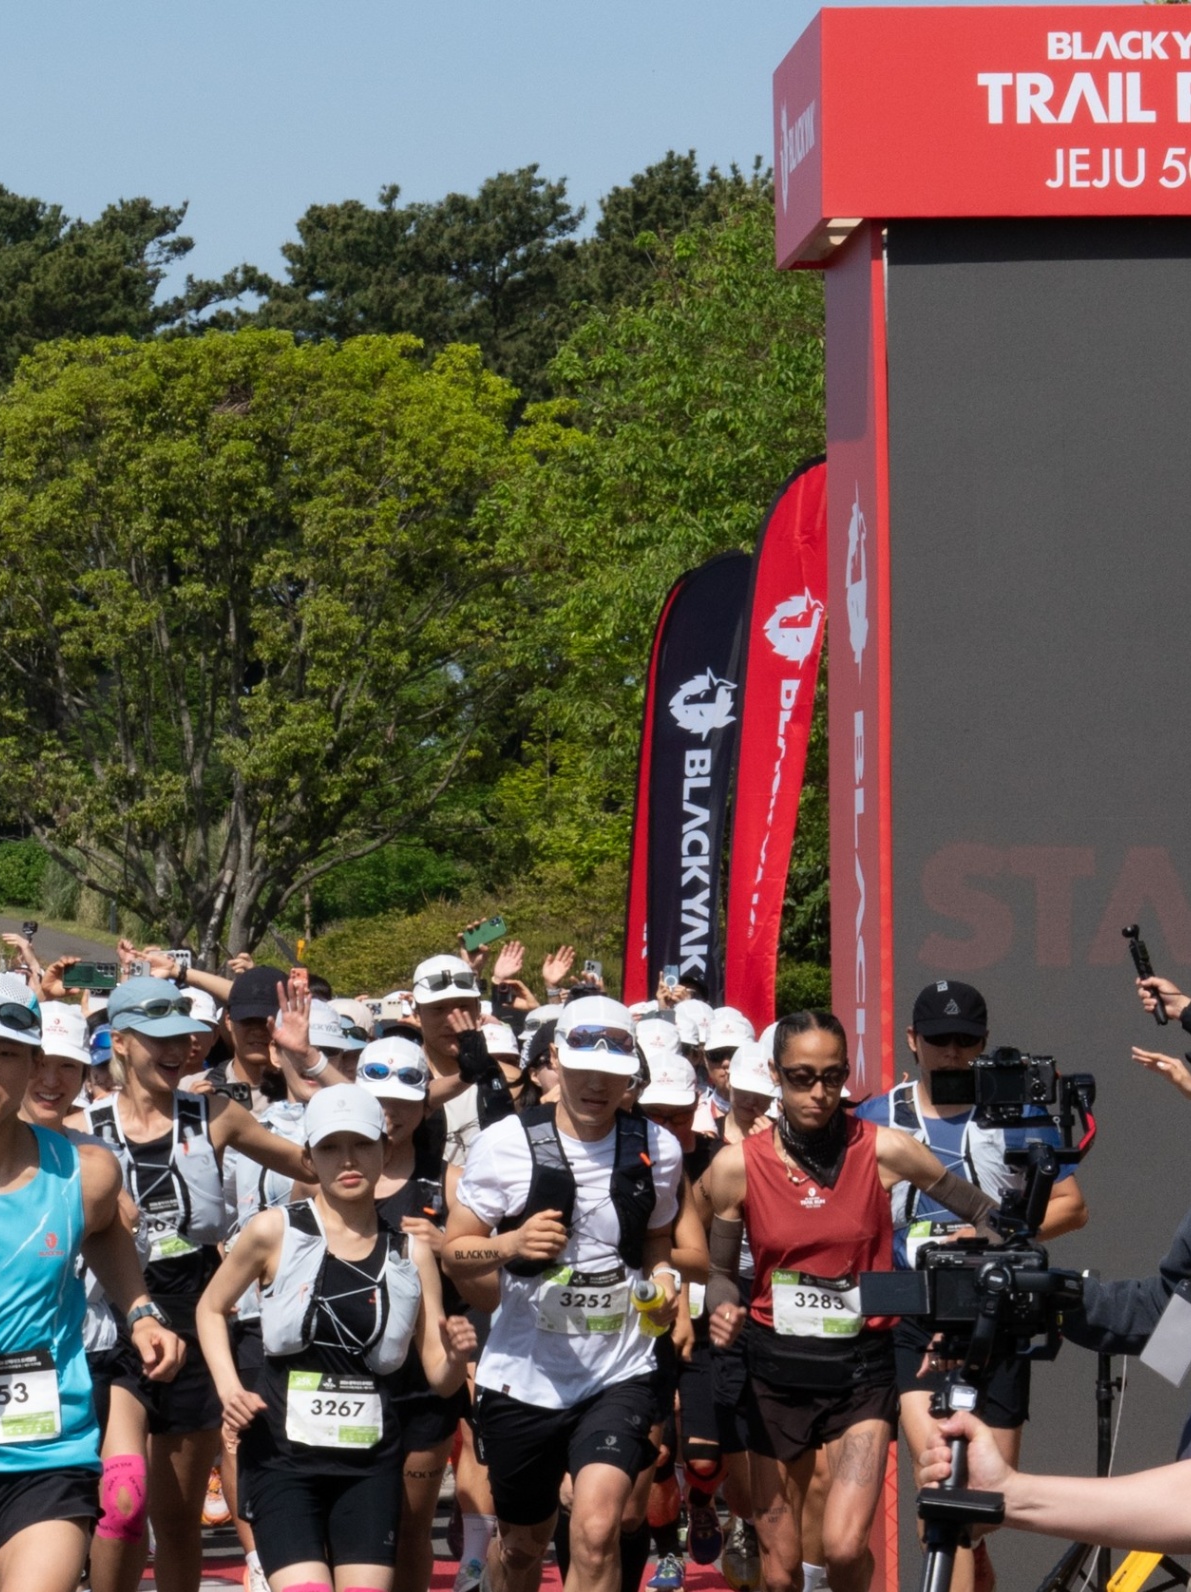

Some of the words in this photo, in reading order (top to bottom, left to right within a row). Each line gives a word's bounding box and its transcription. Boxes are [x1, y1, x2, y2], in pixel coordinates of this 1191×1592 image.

[978, 72, 1156, 124] TRAIL
[1046, 148, 1146, 189] JEJU
[1159, 148, 1191, 189] 5
[680, 750, 712, 979] BLACKYAK
[560, 1293, 612, 1309] 3252
[794, 1292, 844, 1310] 3283
[311, 1399, 366, 1417] 3267
